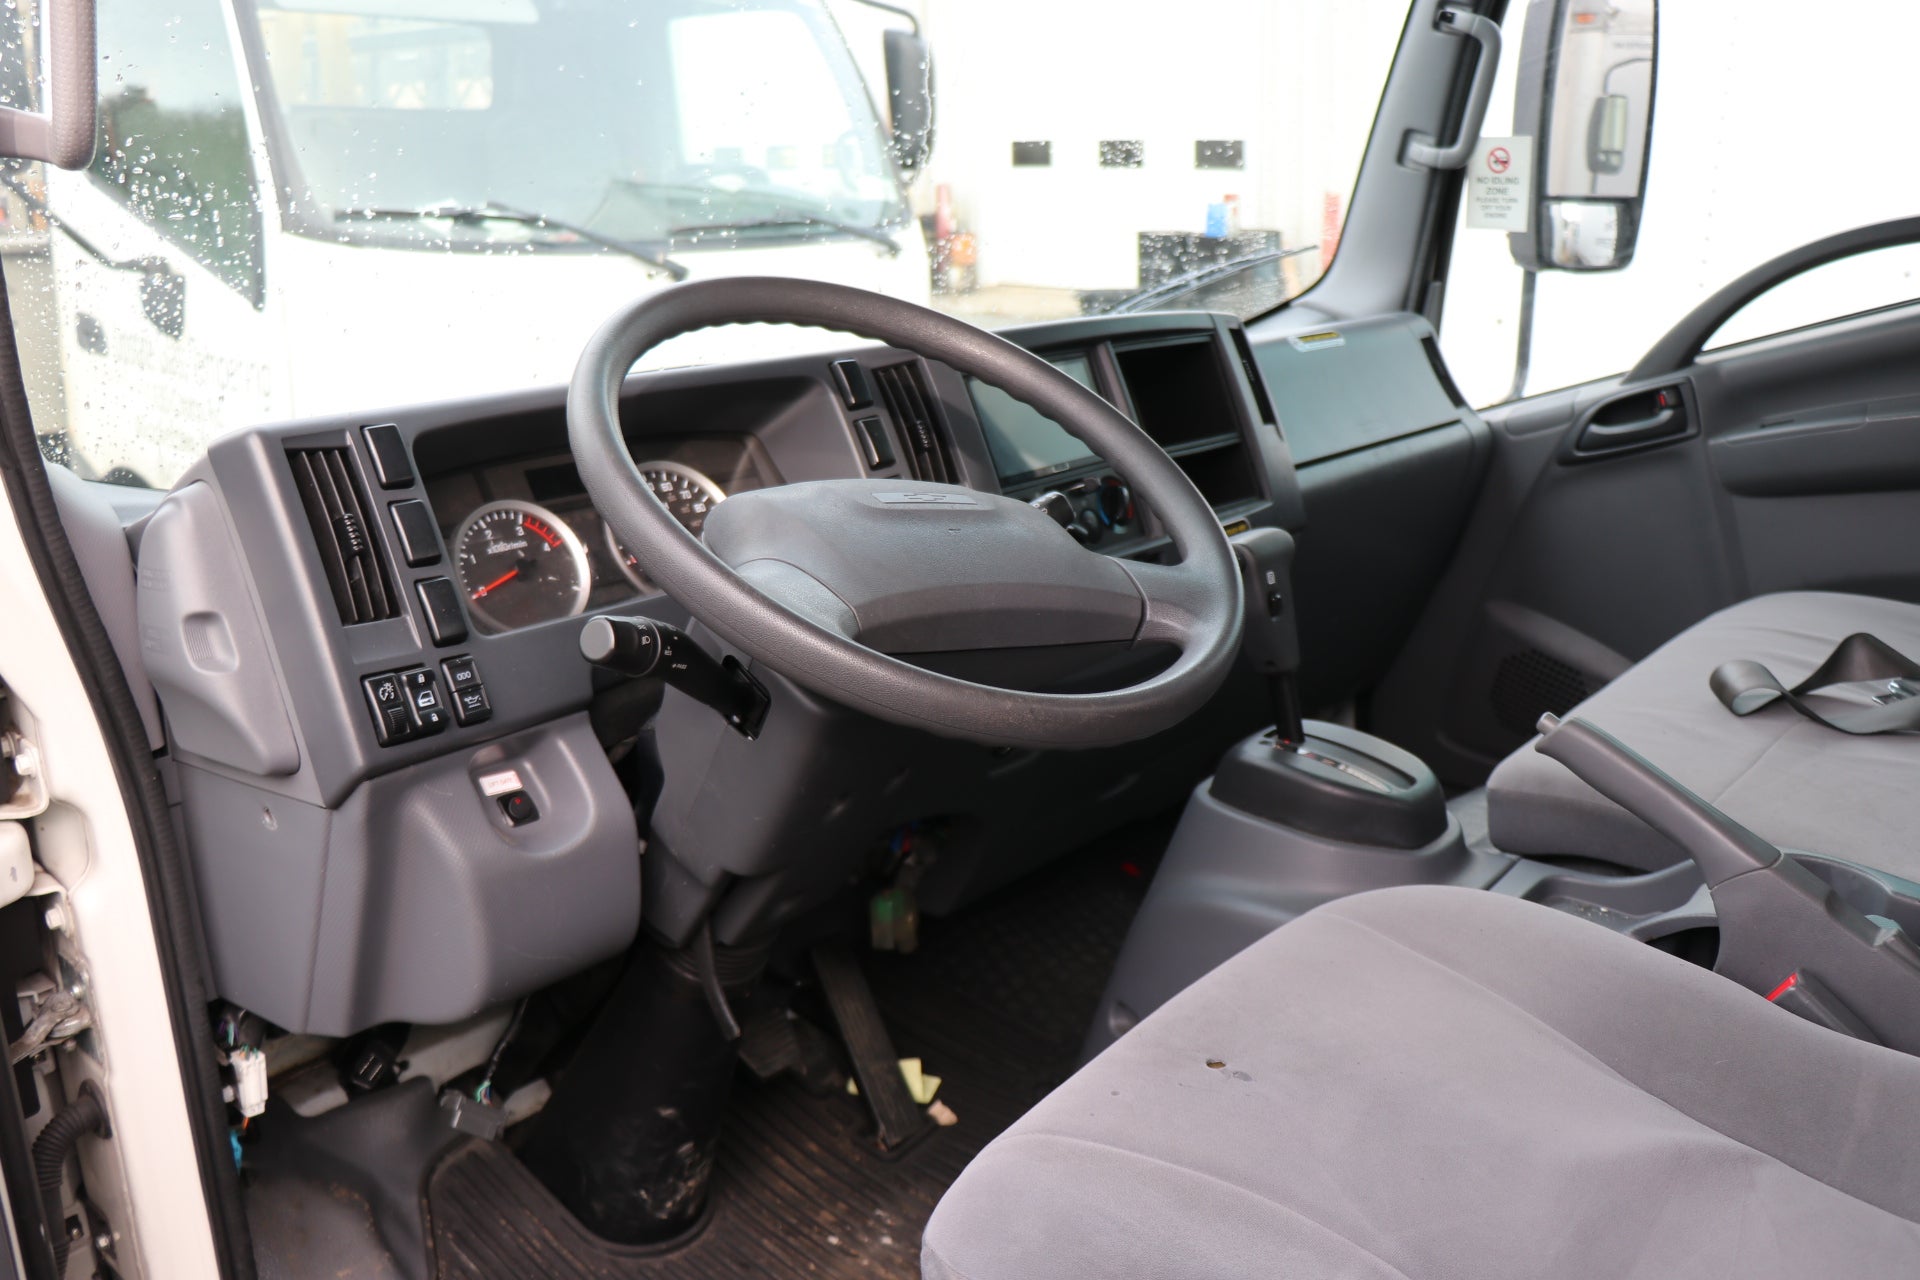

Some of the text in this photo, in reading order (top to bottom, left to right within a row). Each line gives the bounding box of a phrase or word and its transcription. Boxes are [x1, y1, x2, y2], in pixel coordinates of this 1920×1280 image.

[1476, 176, 1520, 186] NO IDLING
[1486, 187, 1510, 196] ZONE
[679, 489, 692, 500] 70
[484, 529, 494, 540] 2
[515, 526, 525, 537] 3
[543, 542, 552, 552] 4
